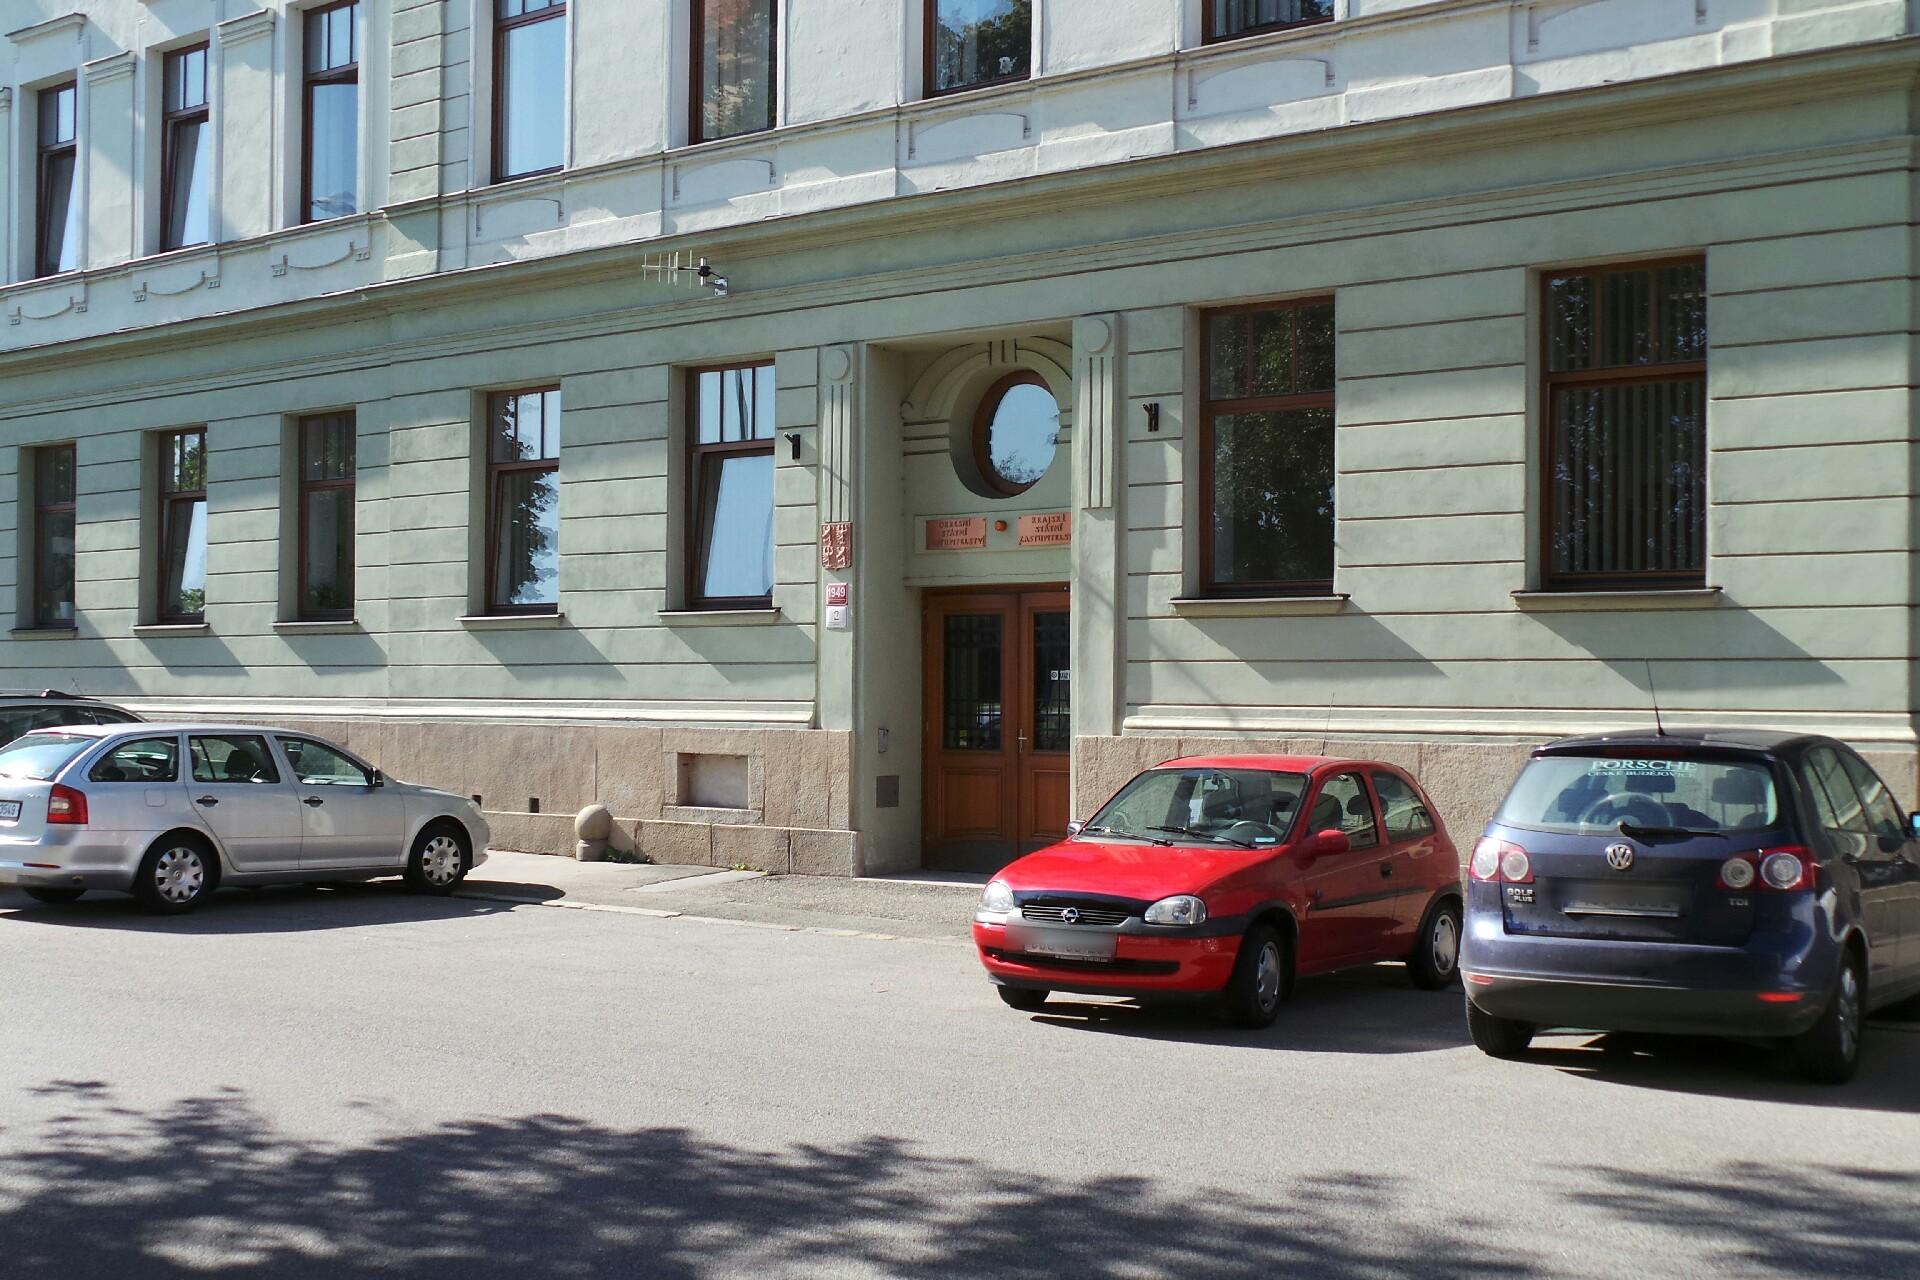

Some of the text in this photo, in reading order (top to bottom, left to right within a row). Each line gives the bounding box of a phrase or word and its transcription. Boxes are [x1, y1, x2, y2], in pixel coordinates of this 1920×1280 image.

[828, 586, 845, 598] 1949
[1591, 760, 1697, 770] PORSCHE
[1507, 888, 1533, 896] GOLF
[1728, 898, 1749, 906] TDI
